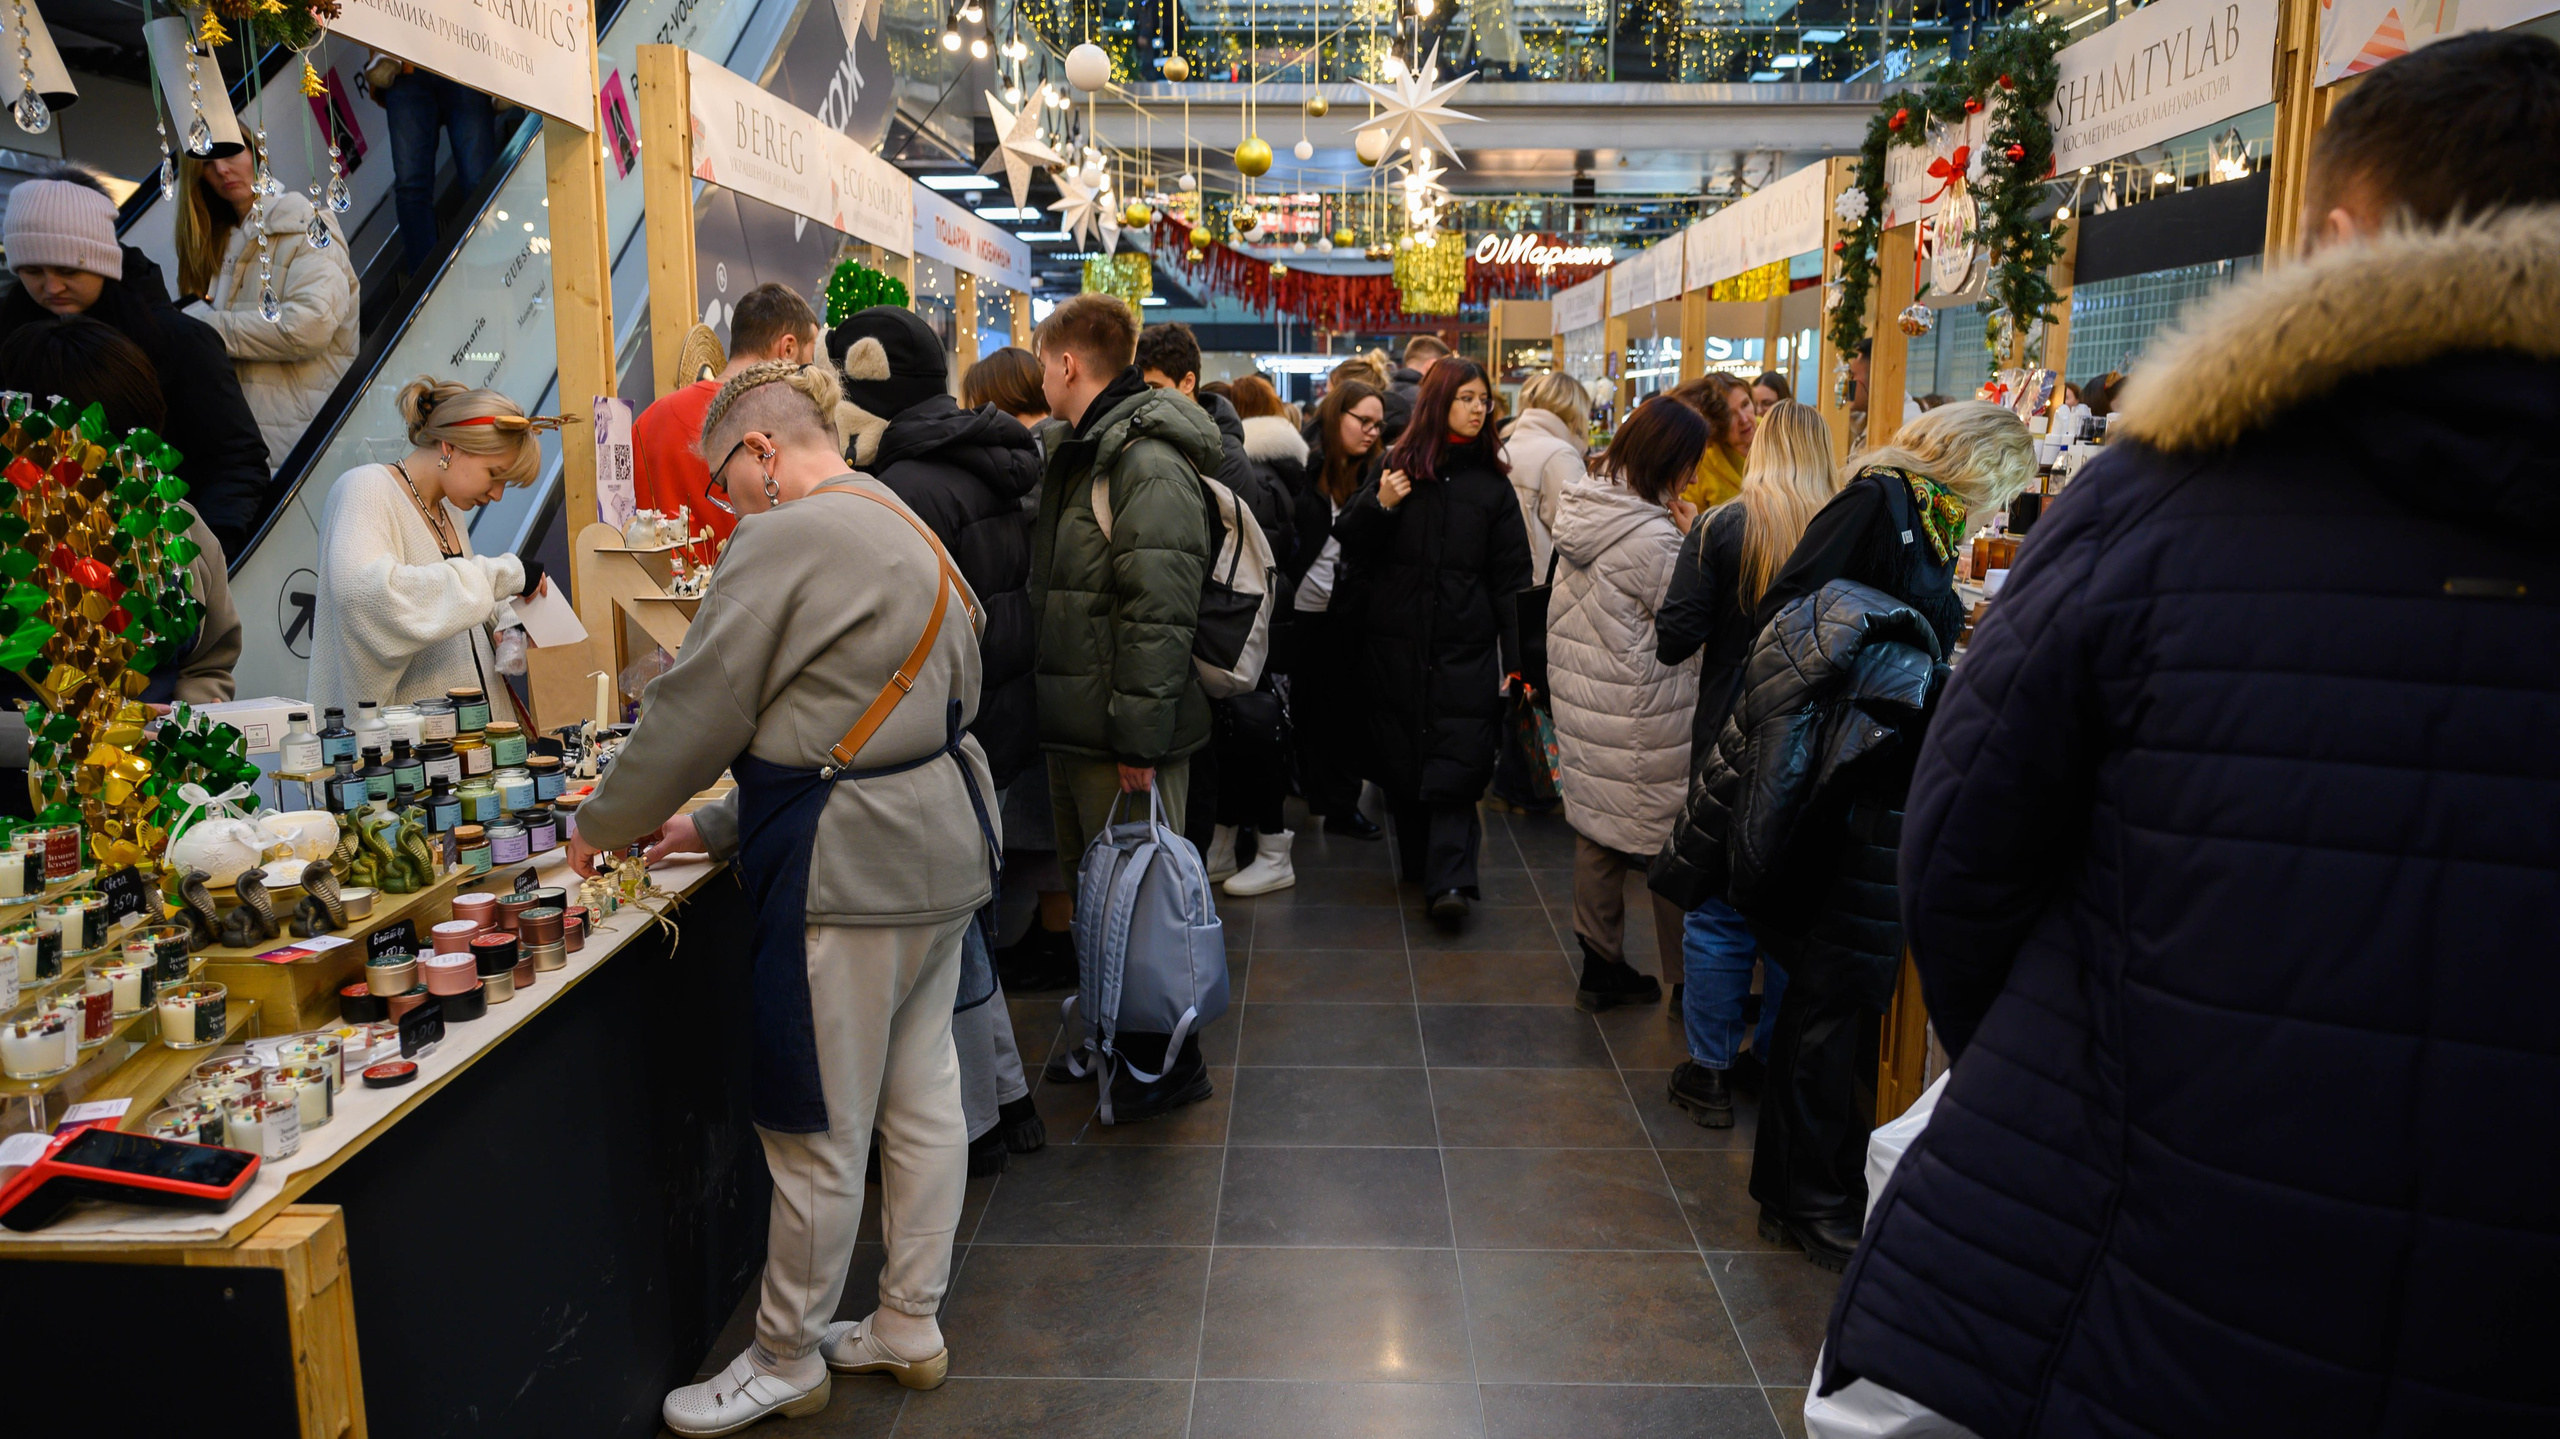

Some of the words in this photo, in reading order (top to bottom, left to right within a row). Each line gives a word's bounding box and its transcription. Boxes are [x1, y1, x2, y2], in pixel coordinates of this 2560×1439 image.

[438, 16, 491, 57] РУЧНОЙ
[494, 41, 535, 76] РАБОТЫ
[2054, 3, 2240, 133] SHAMTYLAB
[735, 99, 804, 175] BEREG
[2062, 107, 2149, 154] КОСМЕТИЧЕСКАЯ
[2151, 73, 2231, 121] МАНУФАКТУРА
[867, 178, 893, 215] SOAP
[934, 214, 971, 254] ПОДАРКИ
[504, 241, 532, 288] GUESS
[450, 316, 486, 367] Tamaris
